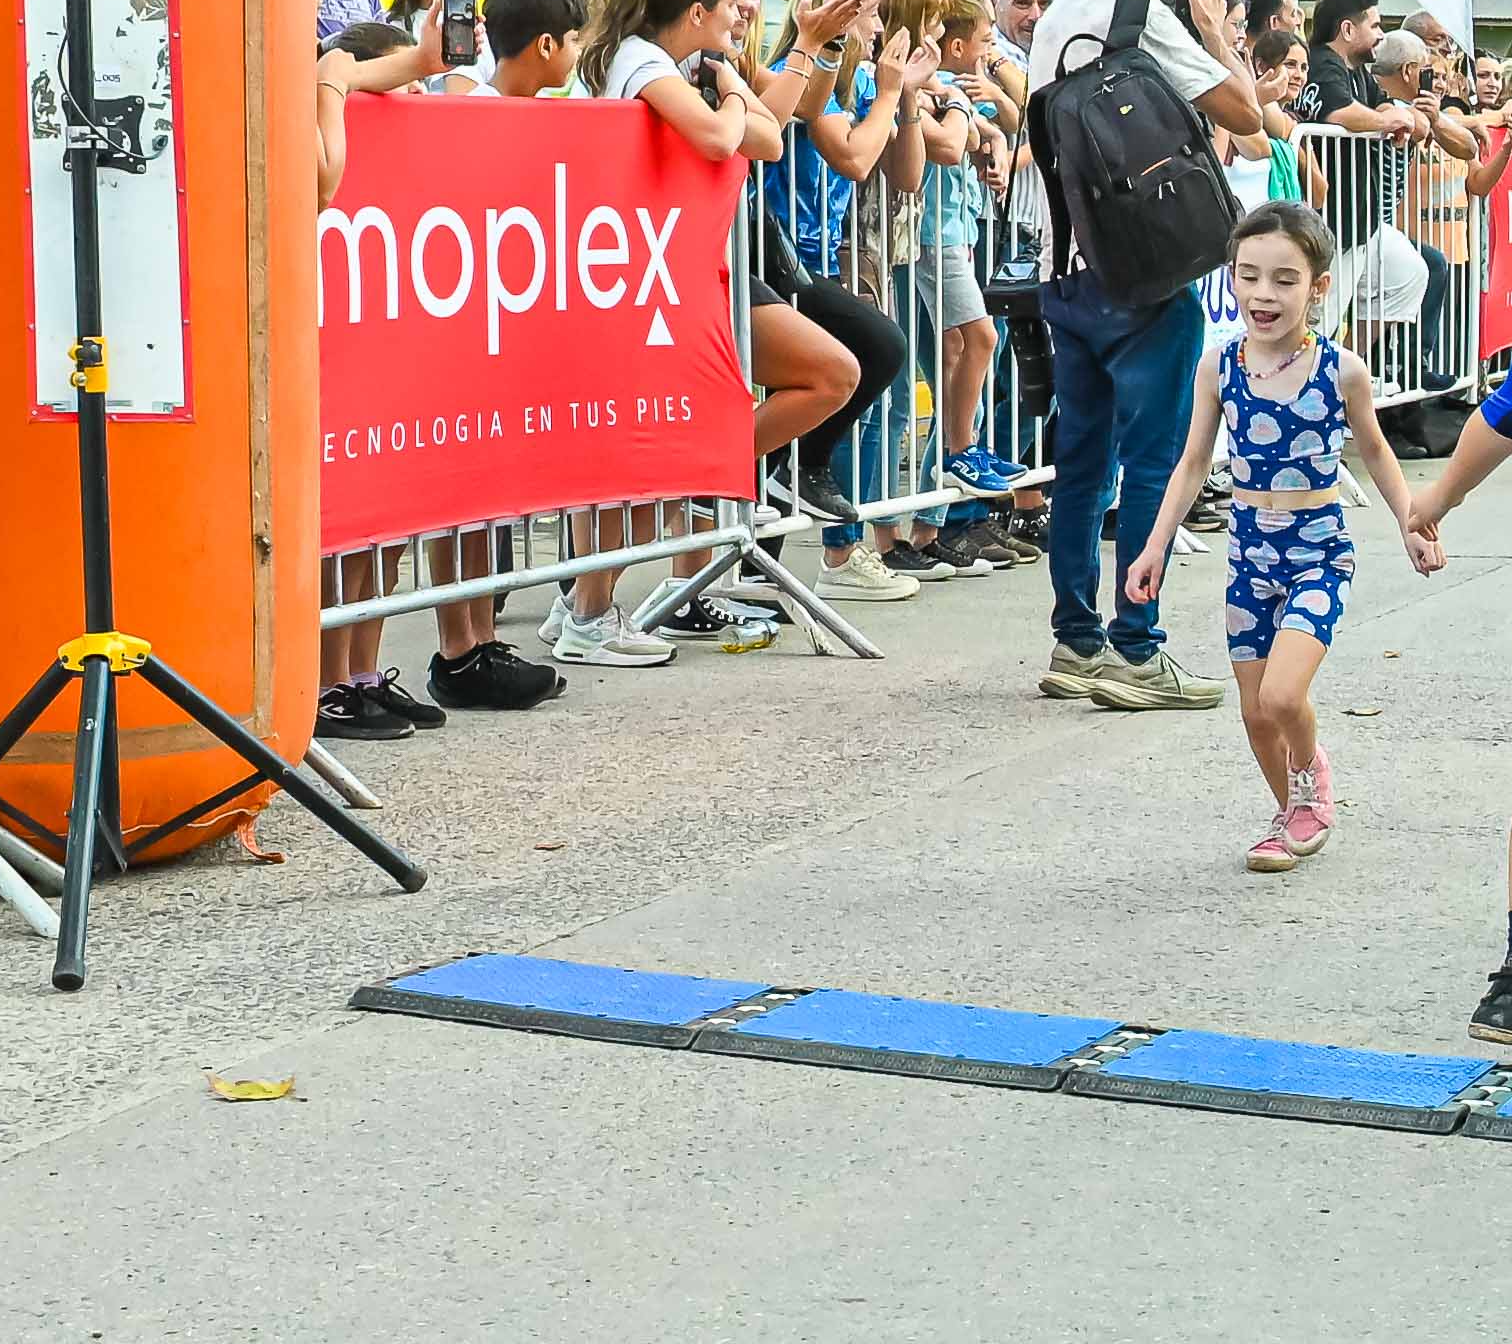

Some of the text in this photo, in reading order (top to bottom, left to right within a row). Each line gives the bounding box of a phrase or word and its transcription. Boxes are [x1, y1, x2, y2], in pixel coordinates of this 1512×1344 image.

[317, 162, 682, 355] moplex
[323, 395, 692, 463] ECNOLOGIA EN TUS PIES
